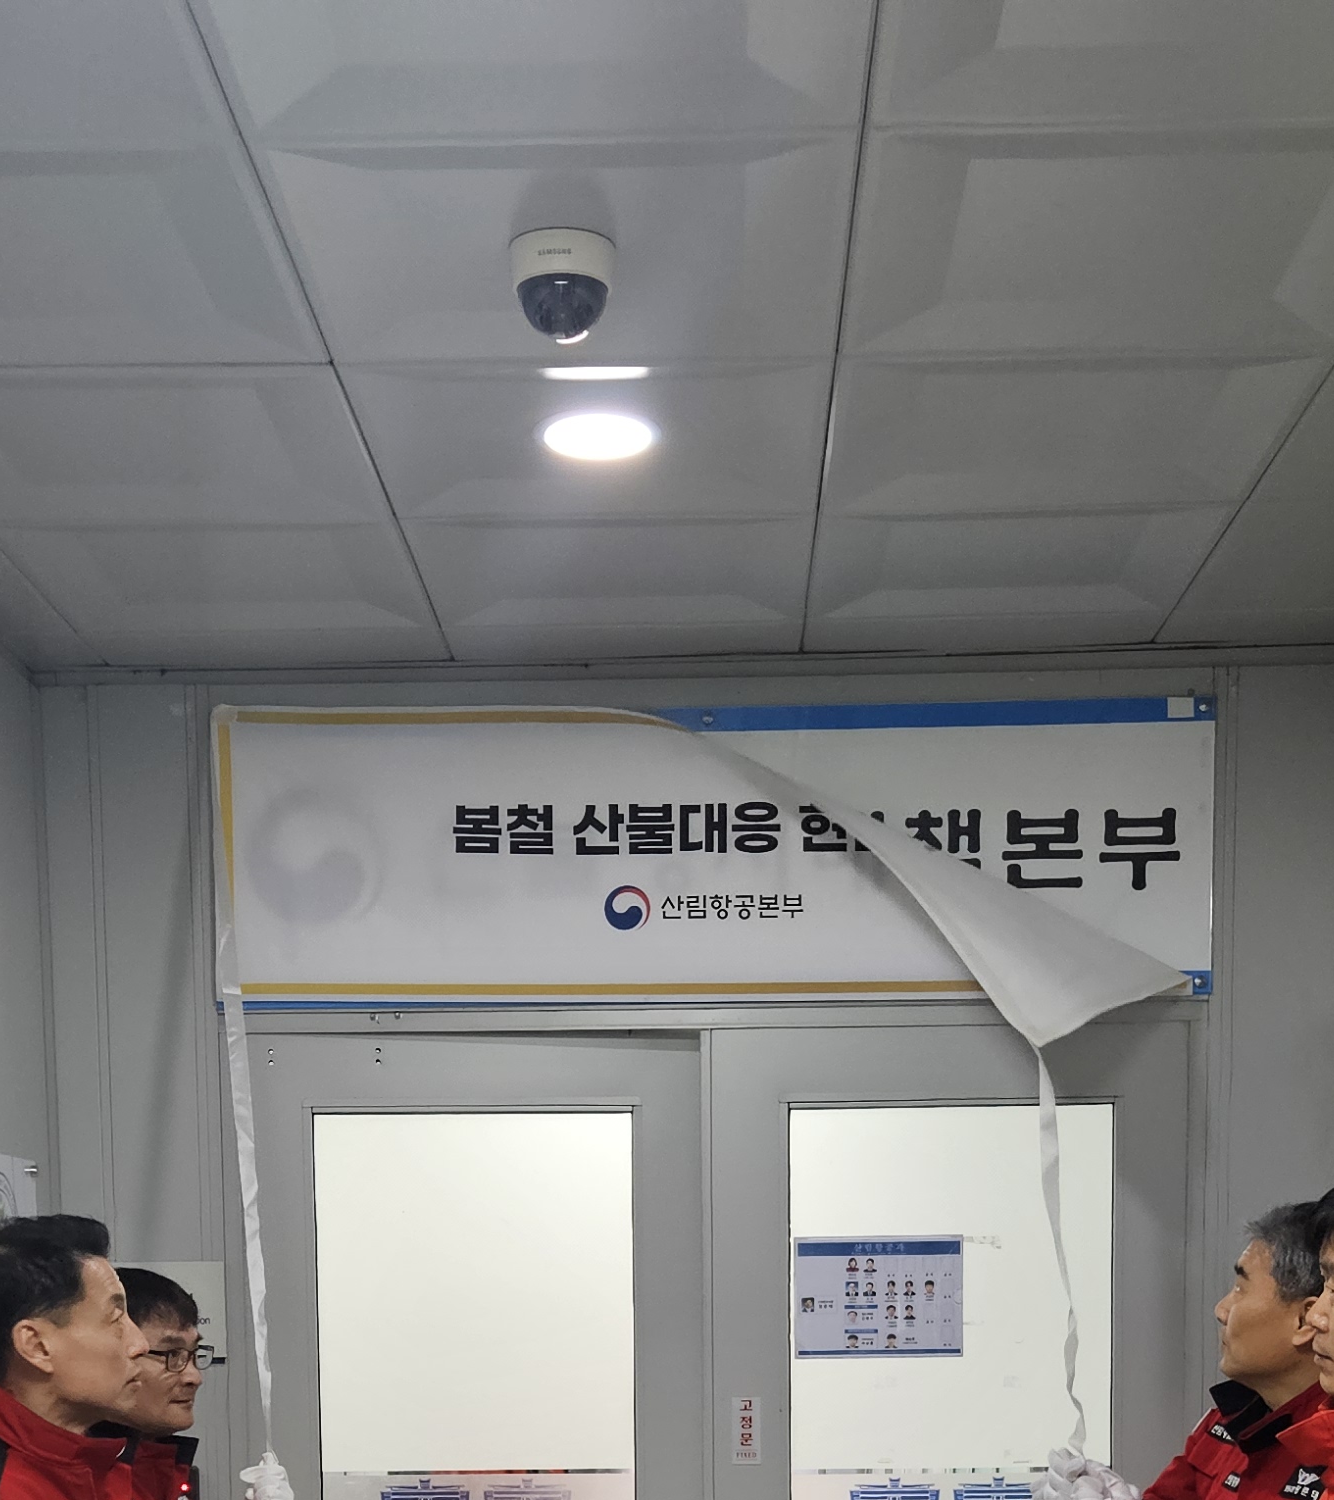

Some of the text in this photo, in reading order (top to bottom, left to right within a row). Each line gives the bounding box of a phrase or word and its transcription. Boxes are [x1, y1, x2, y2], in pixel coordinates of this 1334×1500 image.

[452, 802, 872, 855] 봄철 산불대응 현
[871, 807, 1181, 890] 책본부
[660, 894, 804, 921] 산림항공본부
[739, 1399, 754, 1447] 고정문
